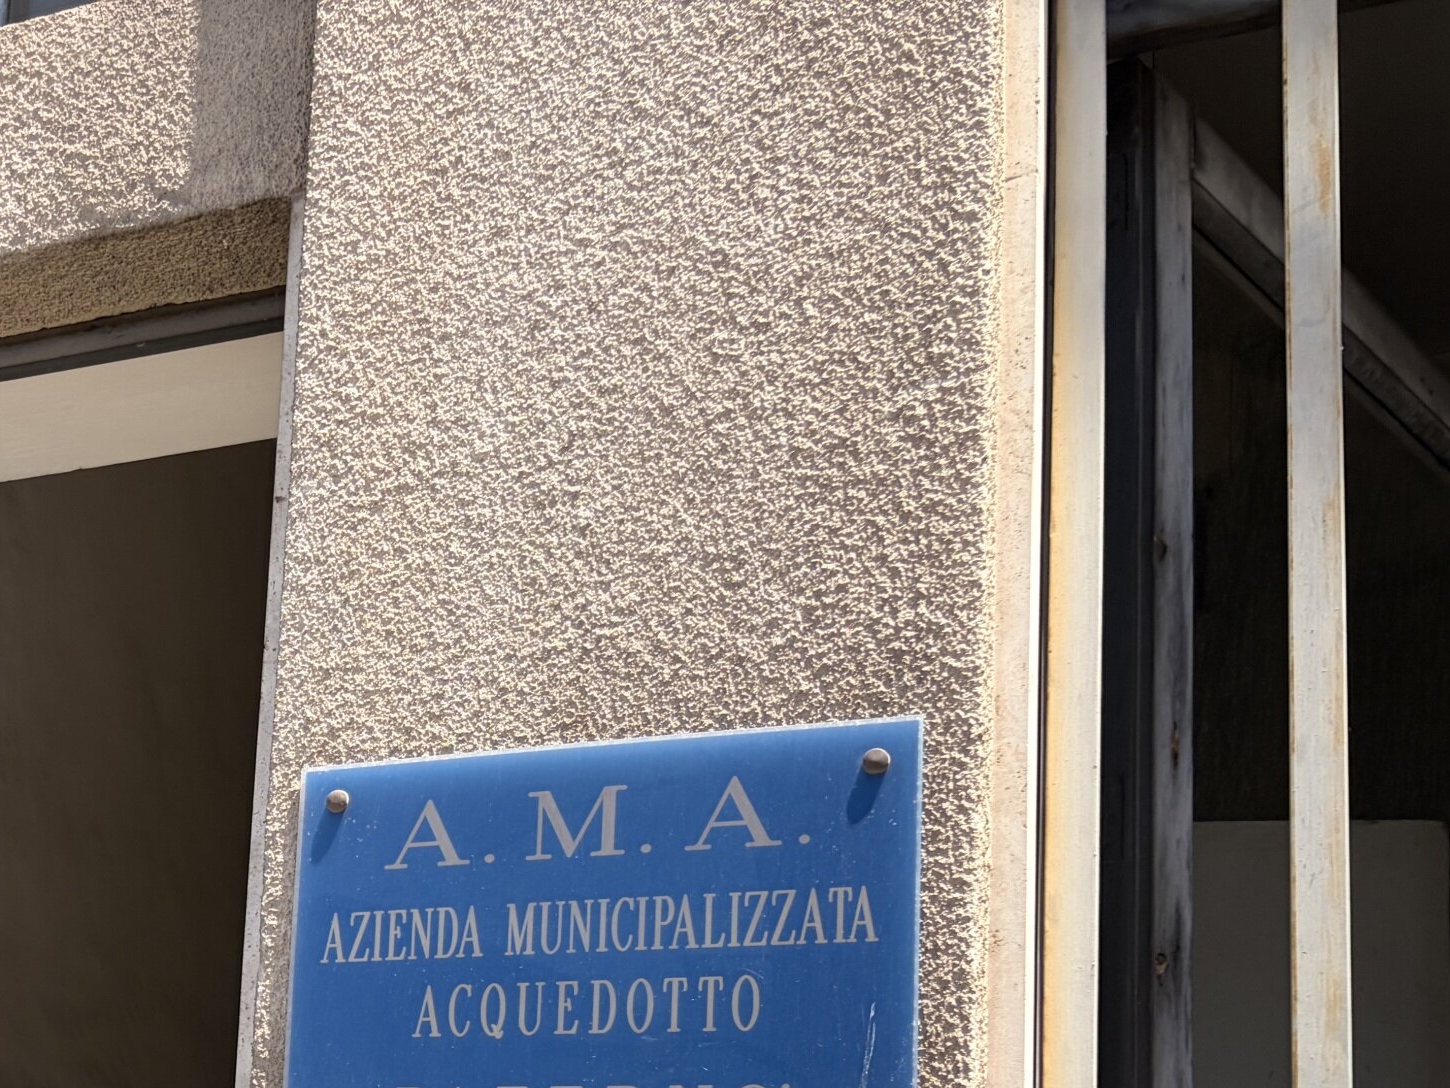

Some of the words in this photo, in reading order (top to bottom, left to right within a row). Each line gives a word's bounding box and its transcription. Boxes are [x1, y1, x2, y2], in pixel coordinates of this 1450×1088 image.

[321, 906, 483, 963] AZIENDA
[505, 886, 878, 955] MUNICIPALIZZATA
[412, 975, 759, 1039] ACQUEDOTTO
